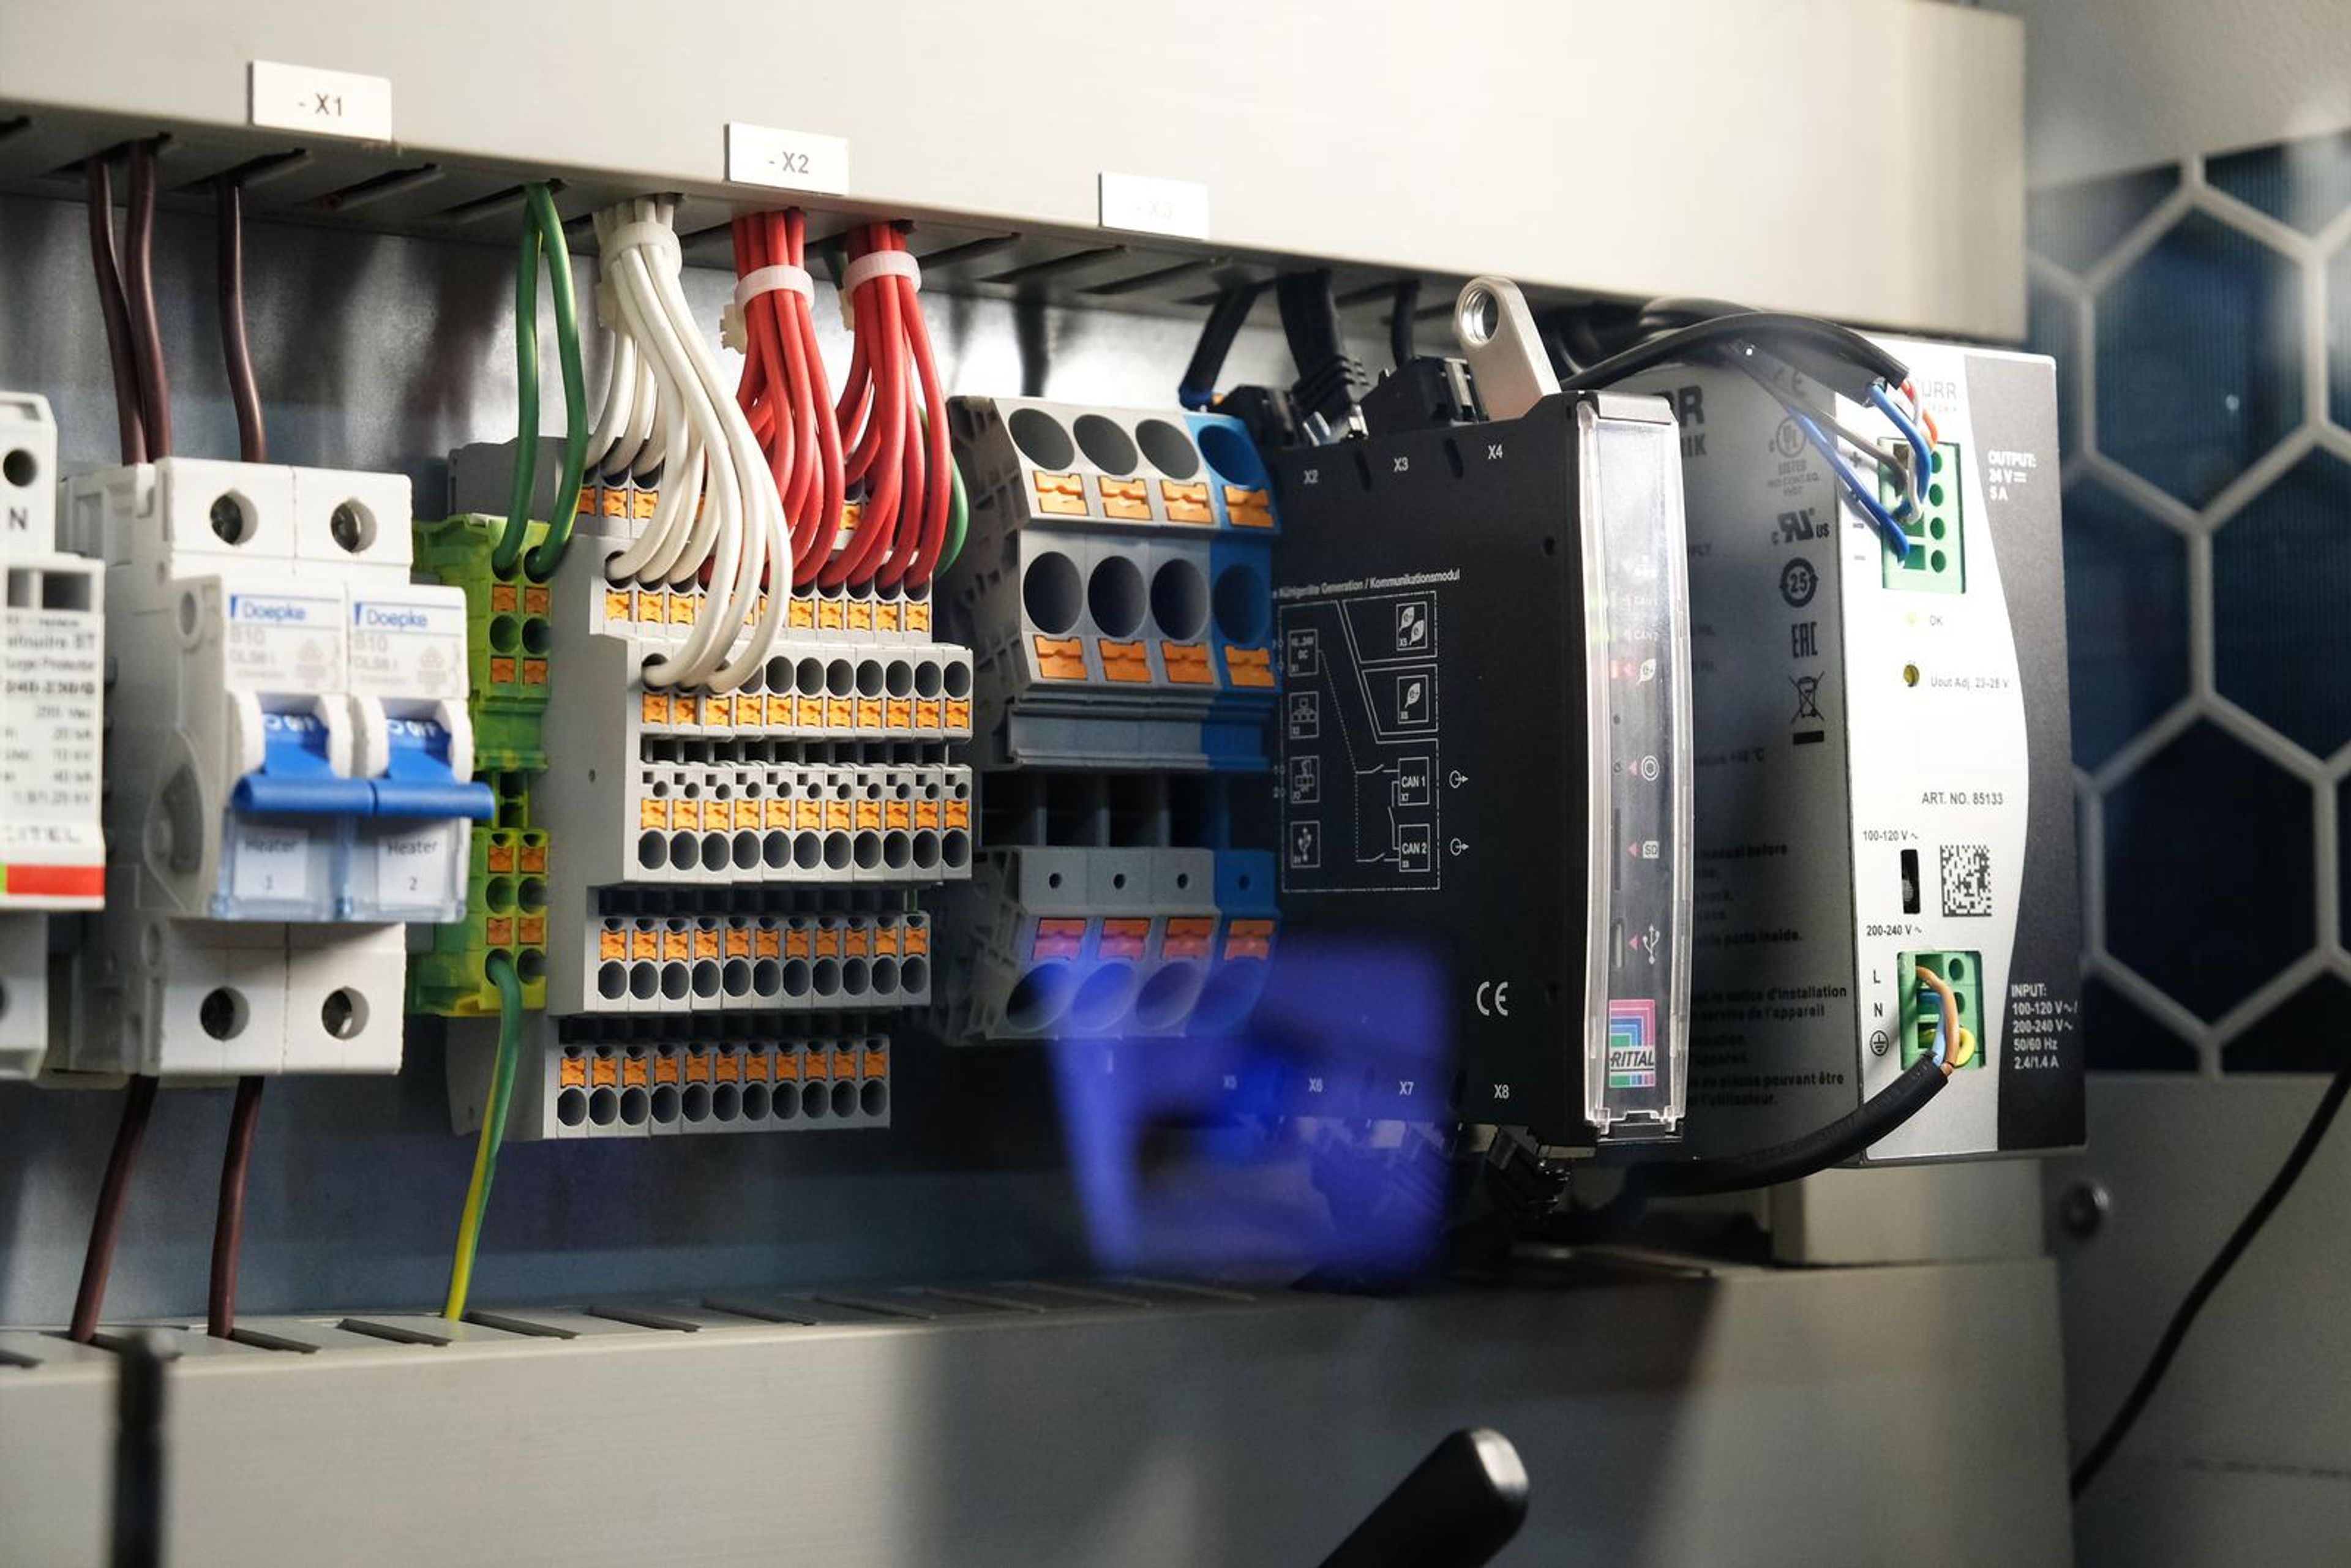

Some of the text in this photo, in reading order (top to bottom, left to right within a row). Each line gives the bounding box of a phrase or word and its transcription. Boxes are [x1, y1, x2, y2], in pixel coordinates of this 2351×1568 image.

[315, 92, 342, 117] X1
[782, 151, 809, 174] X2
[1487, 444, 1504, 460] X4
[1987, 450, 2037, 468] OUTPUT:
[1393, 457, 1409, 473] X3
[1303, 469, 1319, 484] X2
[1998, 486, 2009, 501] A
[9, 507, 29, 531] N
[242, 601, 307, 624] Doepke
[366, 608, 429, 631] Doepke
[1929, 614, 1944, 626] OK
[1401, 775, 1426, 788] CAN 1
[1922, 791, 2004, 806] ART. NO. 85133
[1863, 829, 1899, 842] 100-120
[388, 838, 438, 856] Heater
[1401, 842, 1428, 855] CAN 2
[409, 876, 419, 893] 2
[1866, 924, 1903, 937] 200-240
[1873, 969, 1881, 985] L
[2011, 983, 2047, 998] INPUT:
[1476, 981, 1509, 1017] CE
[1873, 1002, 1883, 1018] N
[2012, 1001, 2053, 1016] 100-120
[2013, 1019, 2054, 1034] 200-240
[2014, 1037, 2058, 1052] 50/60 Hz
[1610, 1049, 1655, 1068] RITTAL
[2014, 1054, 2060, 1070] 2.4/1.4 A
[1308, 1078, 1323, 1093] X6
[1819, 1071, 1845, 1086] être
[1399, 1080, 1415, 1096] X7
[1493, 1082, 1509, 1100] X8
